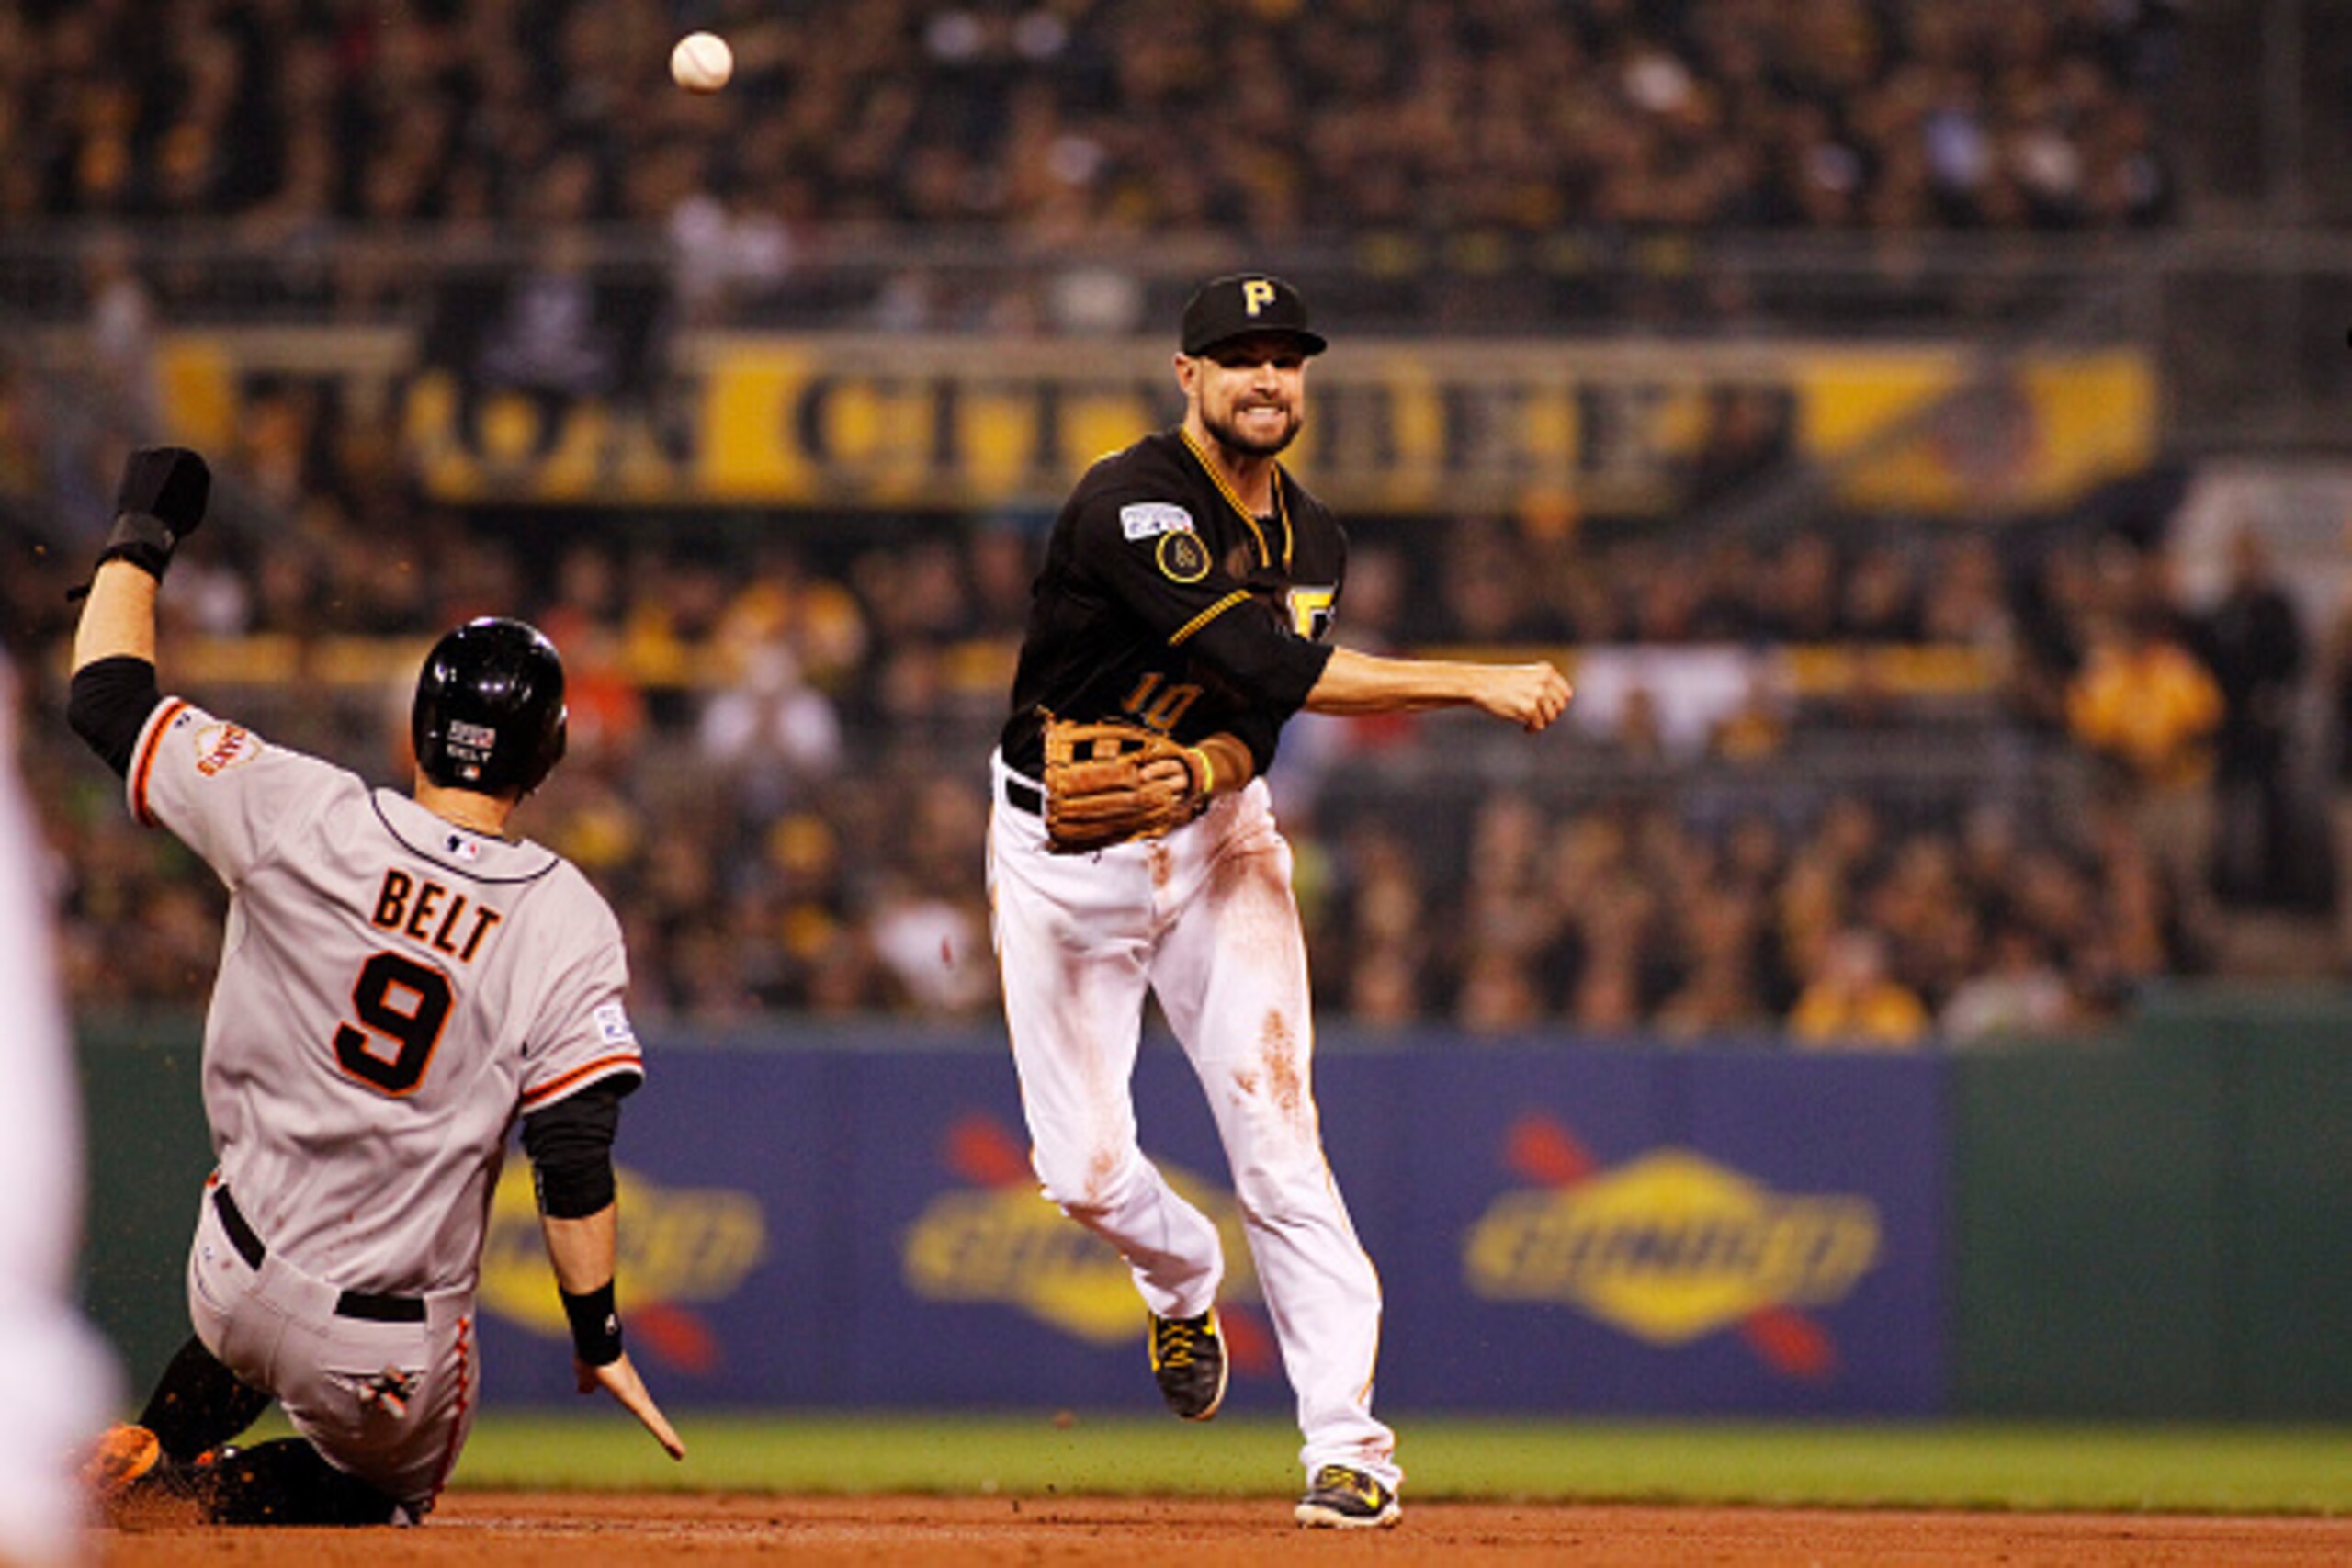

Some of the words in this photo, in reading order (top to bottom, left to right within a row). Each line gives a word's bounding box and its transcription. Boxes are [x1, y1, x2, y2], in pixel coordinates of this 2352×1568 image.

[1243, 280, 1275, 314] P
[1121, 672, 1204, 730] 10
[447, 742, 492, 763] BELT
[371, 867, 503, 964] BELT
[332, 950, 456, 1098] 9
